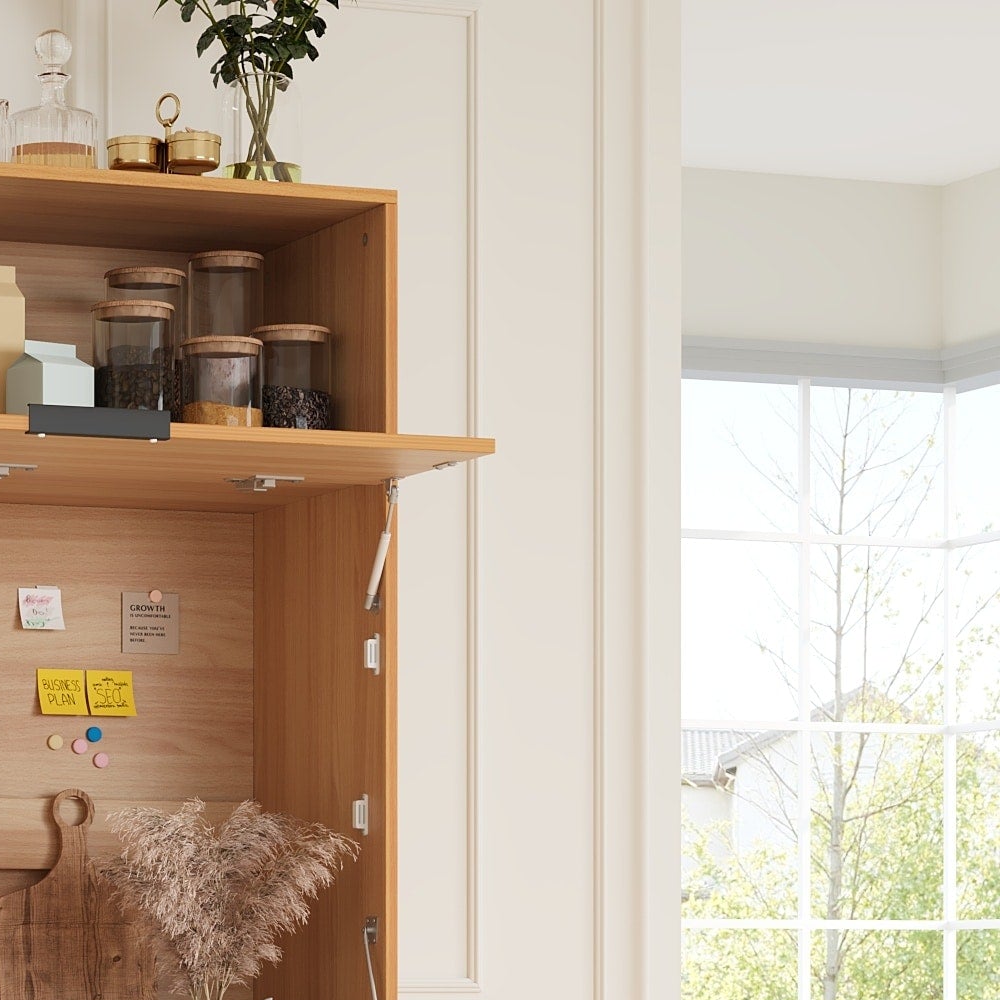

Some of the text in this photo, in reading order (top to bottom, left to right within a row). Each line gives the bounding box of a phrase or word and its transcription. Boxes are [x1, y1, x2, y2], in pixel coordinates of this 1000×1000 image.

[130, 604, 166, 612] GROWTH
[41, 678, 81, 693] BUSINESS
[47, 693, 77, 706] PLAN
[96, 688, 121, 705] SEO
